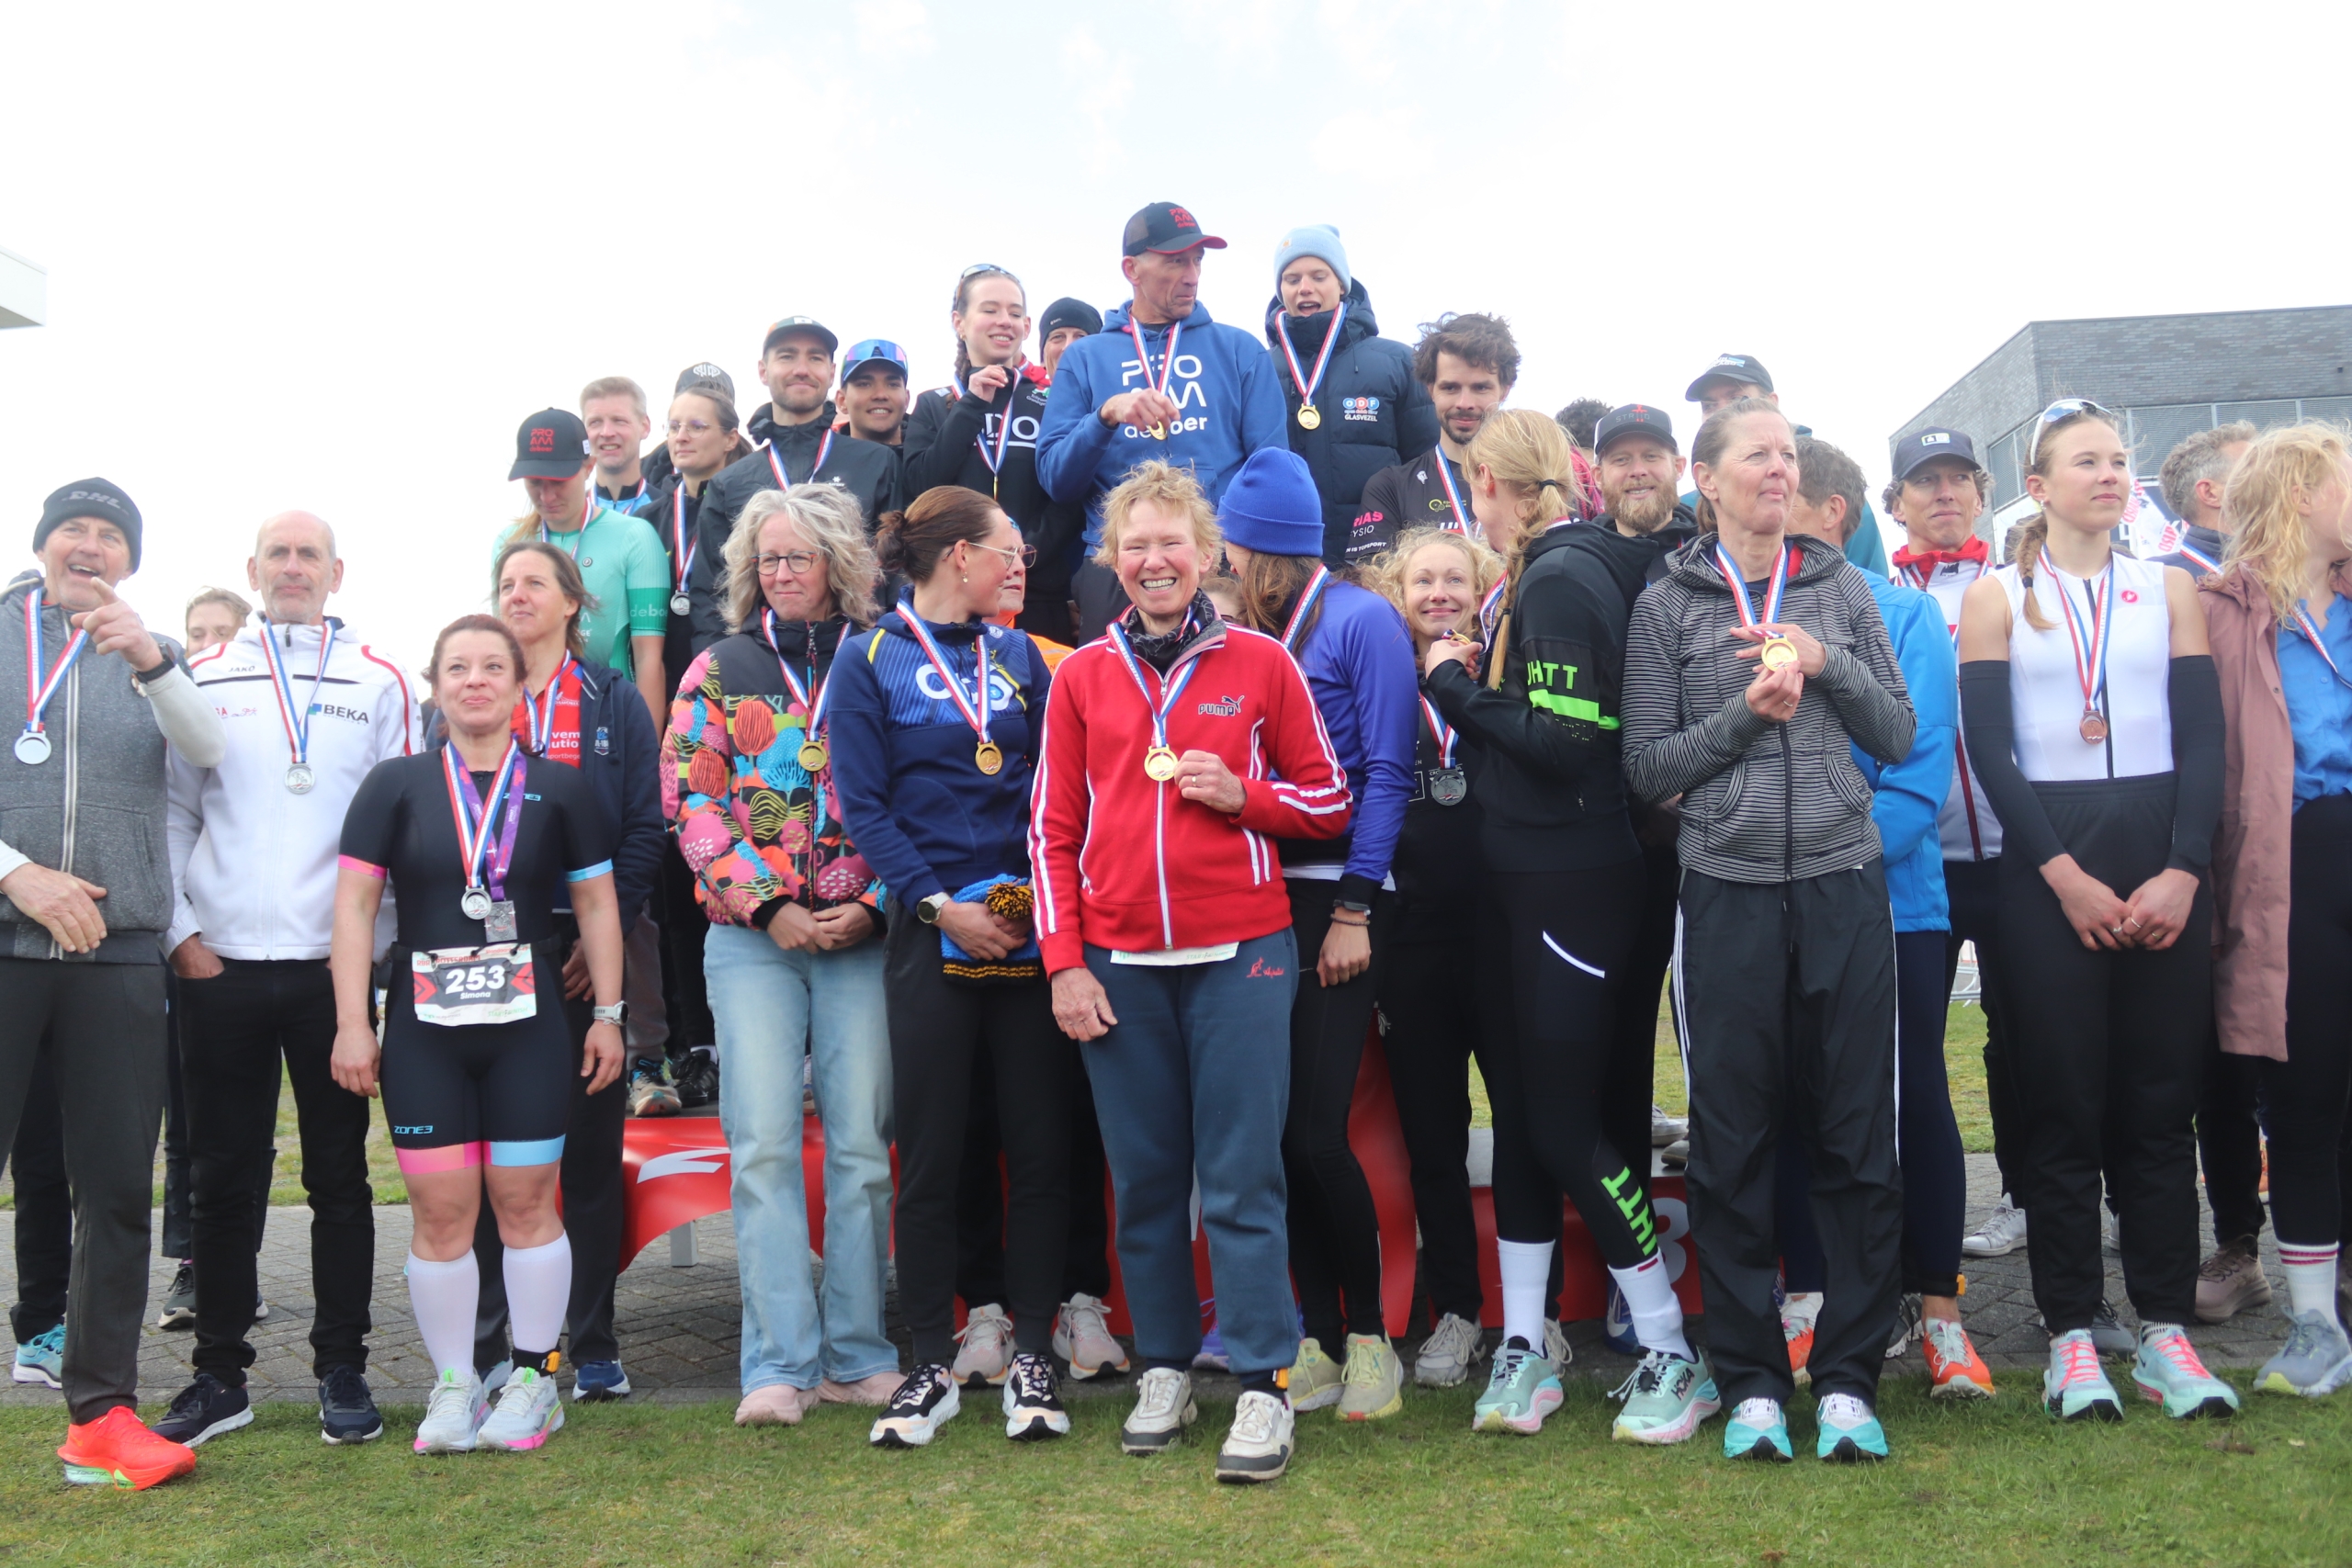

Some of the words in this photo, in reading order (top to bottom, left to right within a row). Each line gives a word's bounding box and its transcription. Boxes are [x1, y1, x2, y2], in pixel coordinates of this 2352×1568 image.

[530, 428, 554, 436] PRO
[530, 437, 553, 446] AM
[69, 491, 120, 509] DHL
[1351, 525, 1374, 537] YSIO
[1286, 604, 1306, 640] TRIATHLON
[2098, 599, 2107, 644] NEDERLANDSE
[911, 620, 929, 642] DUATHLON
[925, 639, 944, 665] STANDAARD
[324, 705, 368, 724] BEKA
[1198, 704, 1236, 716] PUMA
[446, 965, 505, 994] 253
[460, 991, 491, 999] Simona
[394, 1125, 433, 1134] ZONE3
[1671, 1368, 1695, 1401] HOKA
